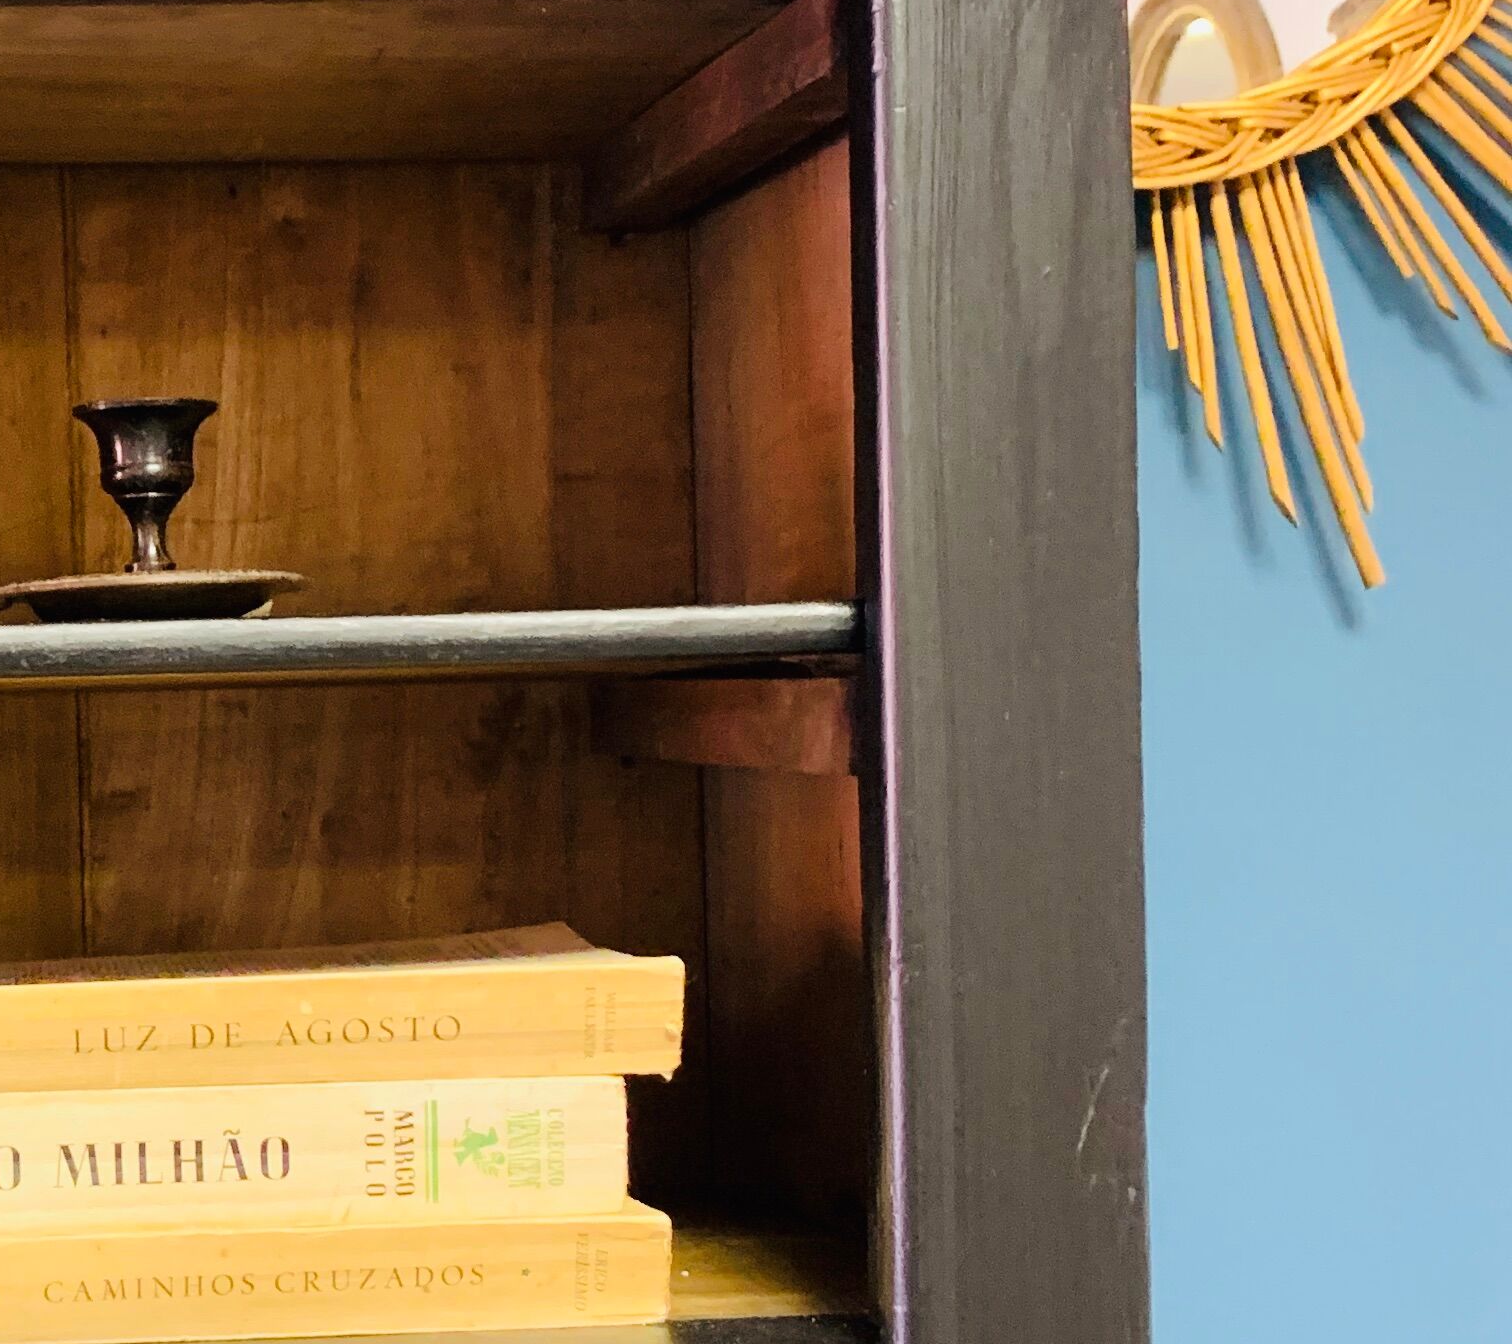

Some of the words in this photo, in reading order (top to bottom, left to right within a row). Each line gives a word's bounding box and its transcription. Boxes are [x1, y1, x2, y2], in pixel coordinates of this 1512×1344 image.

[74, 1025, 159, 1055] LUZ
[189, 1022, 243, 1050] DE
[276, 1015, 462, 1047] AGOSTO
[53, 1129, 290, 1189] MILHÃO
[364, 1110, 386, 1197] POLO
[394, 1110, 416, 1196] MARCO
[43, 1273, 256, 1304] CAMINHOS
[274, 1263, 486, 1294] CRUZADOS
